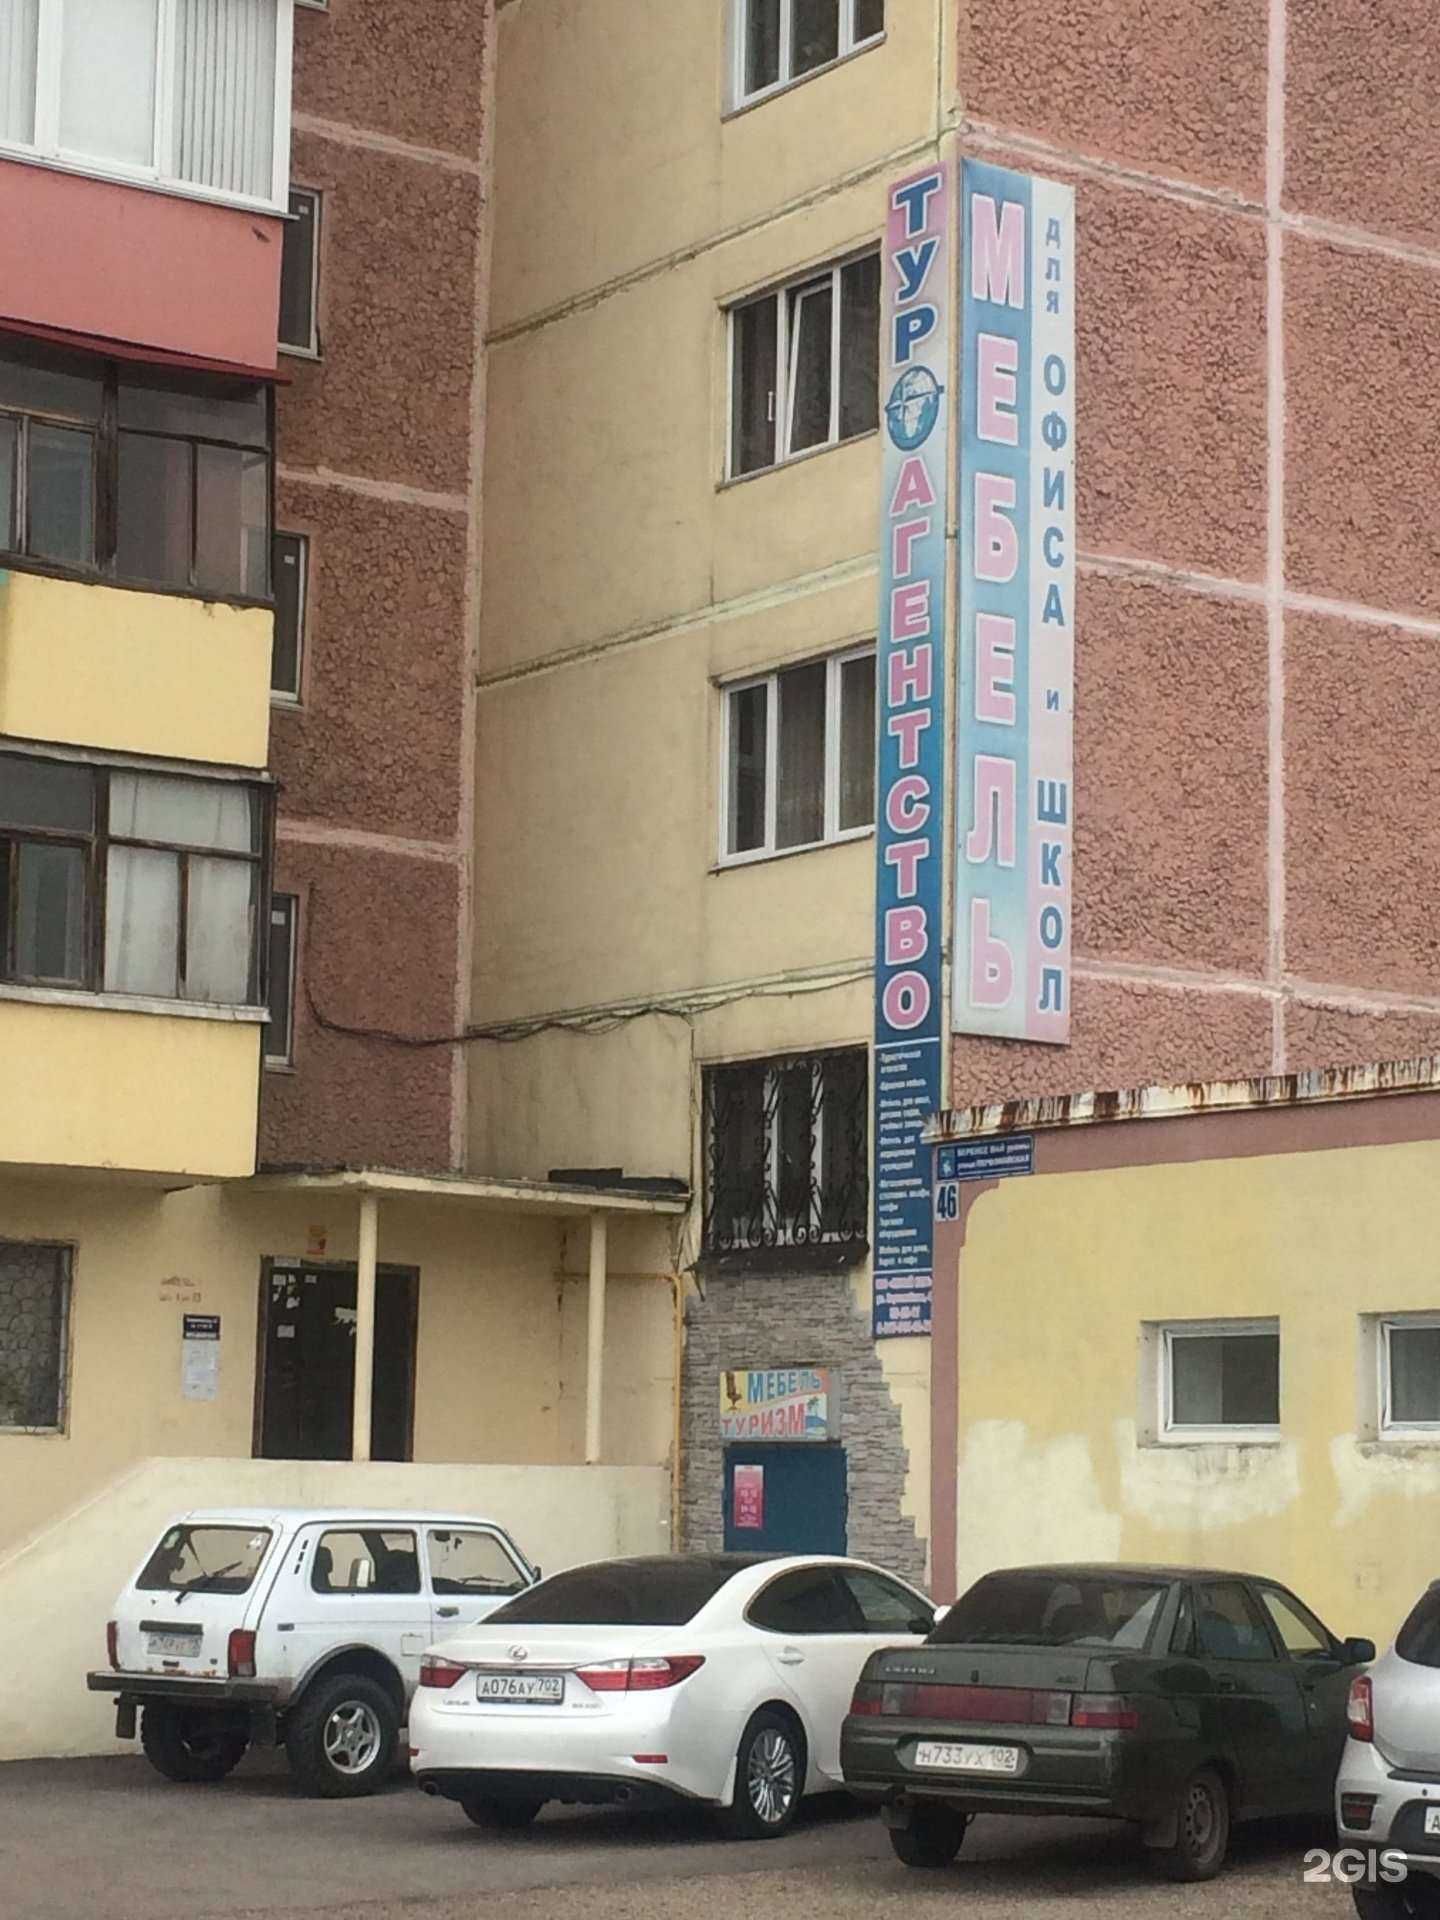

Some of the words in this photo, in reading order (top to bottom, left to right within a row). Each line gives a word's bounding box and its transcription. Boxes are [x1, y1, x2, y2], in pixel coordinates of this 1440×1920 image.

[1041, 353, 1068, 627] ОФИСА
[966, 192, 1026, 1010] МЕБЕЛЬ
[1037, 779, 1067, 1012] ШКОЛ
[937, 1184, 957, 1219] 46
[721, 1402, 806, 1436] ТУРИЗМ
[747, 1370, 822, 1404] МЕБЕЛЬ
